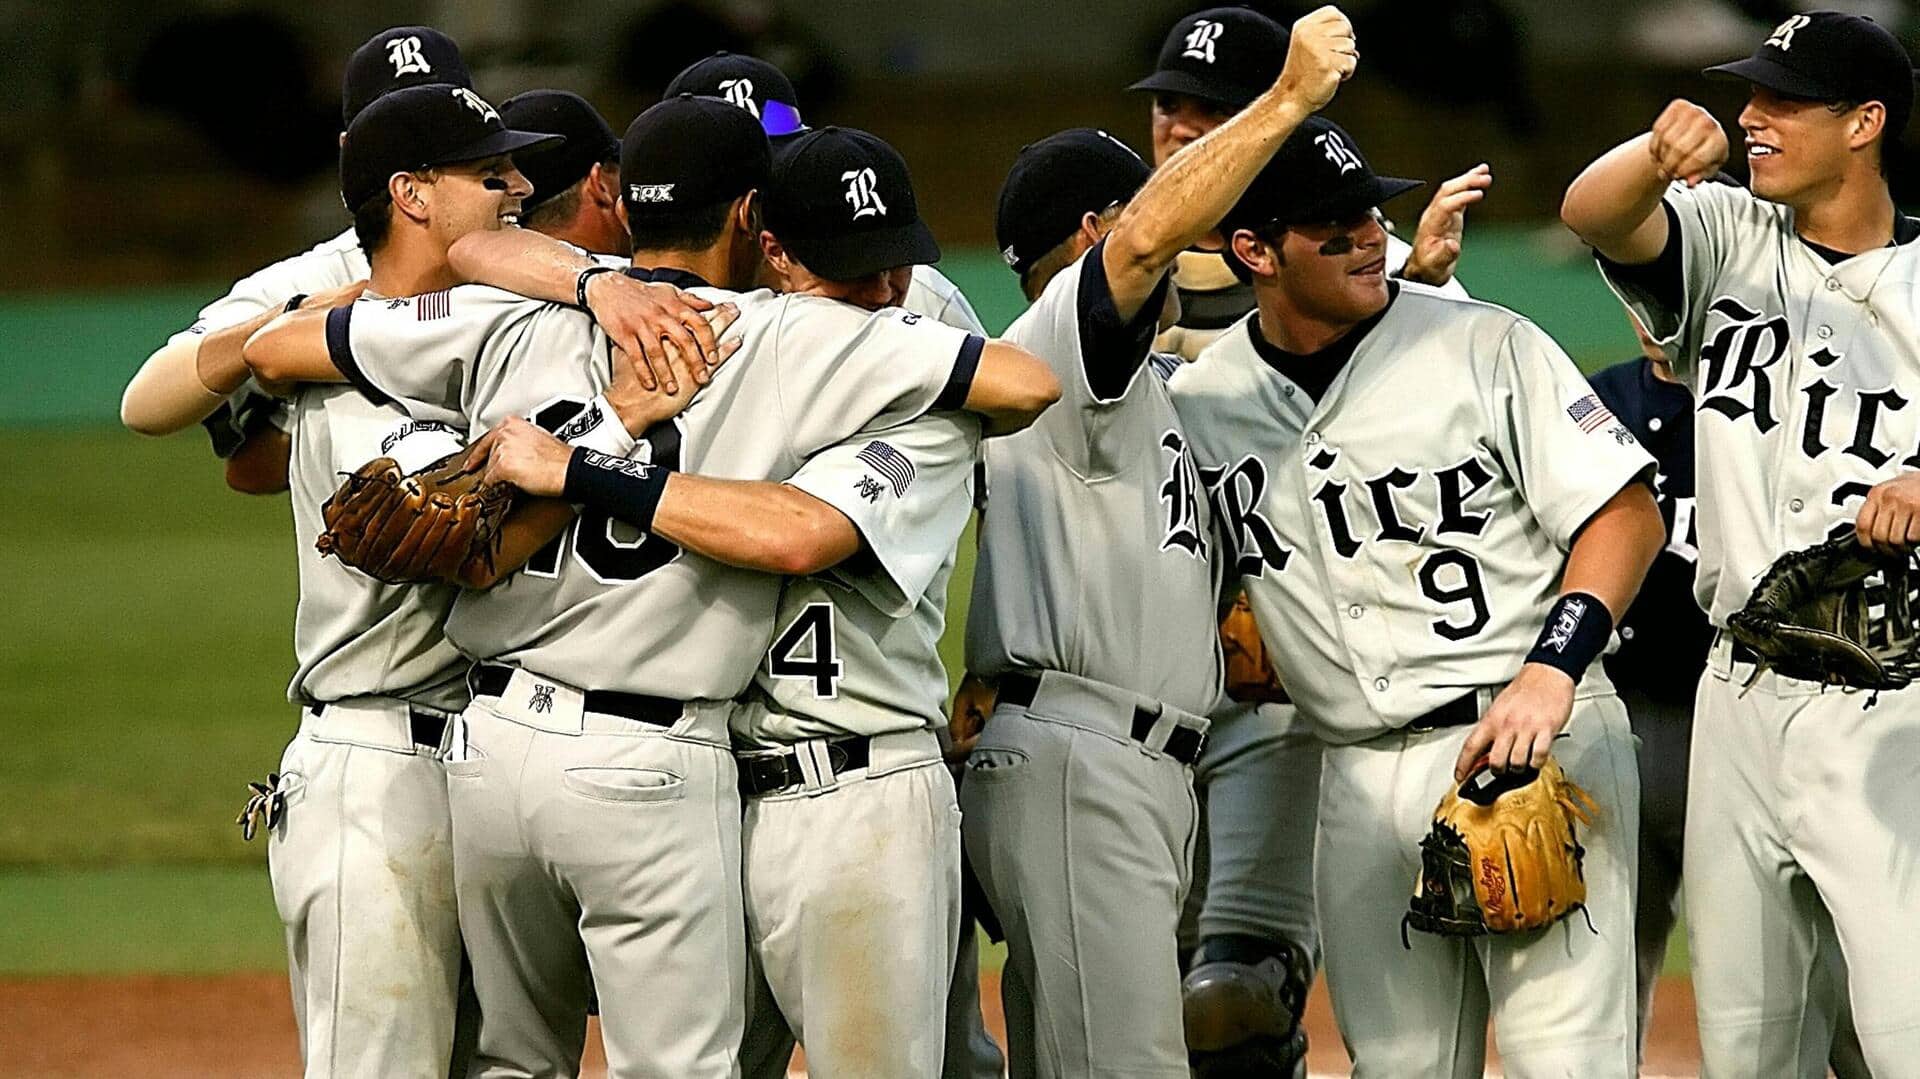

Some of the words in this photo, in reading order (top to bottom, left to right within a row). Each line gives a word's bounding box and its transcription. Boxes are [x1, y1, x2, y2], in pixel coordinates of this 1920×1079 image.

[1182, 19, 1225, 65] R
[1764, 13, 1812, 52] R
[385, 35, 432, 79] R
[717, 78, 761, 121] R
[1314, 130, 1364, 176] R
[629, 183, 675, 203] TPX
[840, 166, 888, 221] R
[1697, 295, 1920, 470] Ric
[584, 448, 657, 480] TPX
[1199, 447, 1497, 580] Rice
[1416, 547, 1493, 643] 9
[1540, 599, 1588, 654] TPX
[767, 601, 845, 700] 4
